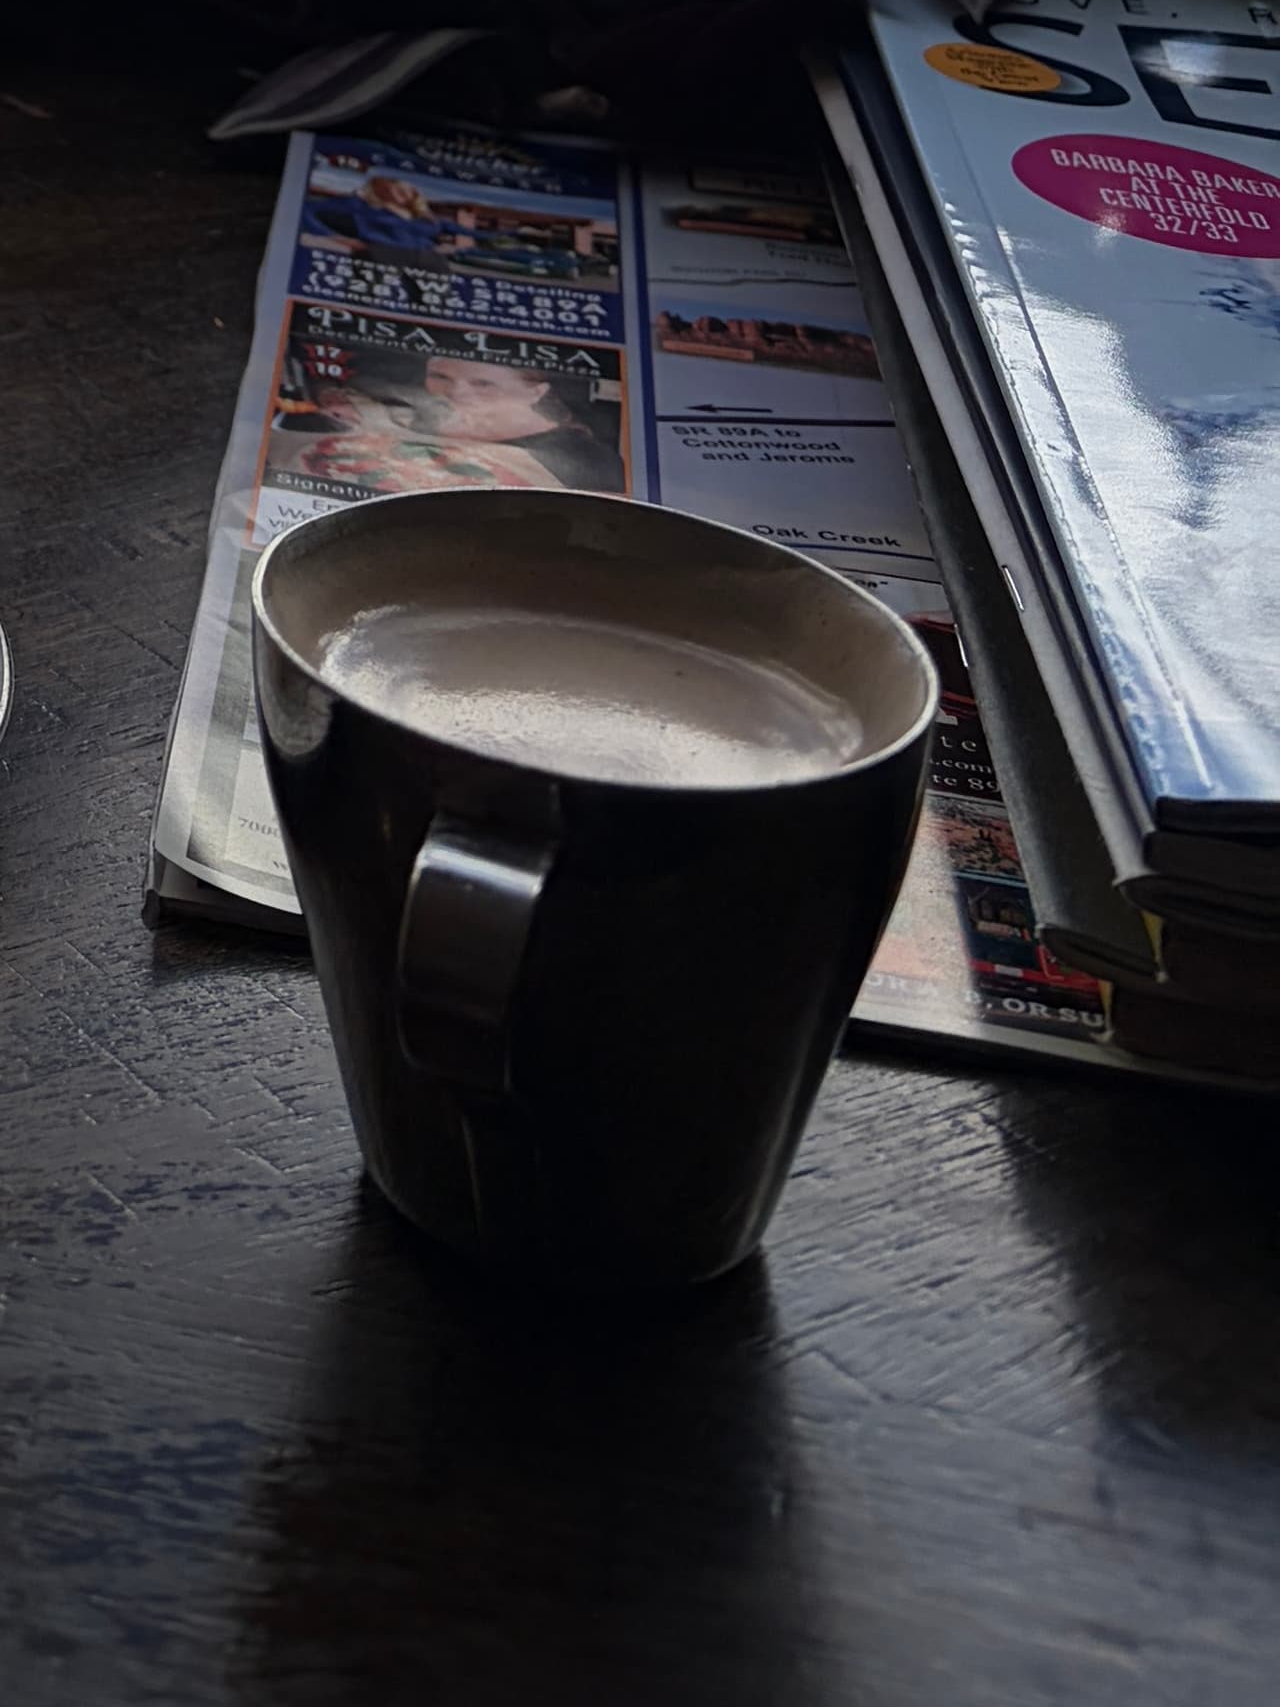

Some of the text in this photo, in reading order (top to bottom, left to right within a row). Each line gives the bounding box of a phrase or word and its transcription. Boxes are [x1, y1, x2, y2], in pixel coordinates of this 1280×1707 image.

[1050, 149, 1280, 198] BARBARA BAKER
[1131, 176, 1224, 206] AT THE
[1098, 187, 1271, 230] CENTERFOLD
[1149, 212, 1238, 242] 32/33
[312, 250, 398, 273] Express
[403, 266, 465, 284] Wash
[496, 281, 601, 303] Detailing
[312, 260, 401, 286] 1515
[474, 288, 518, 304] SR
[533, 296, 608, 316] 89A
[302, 284, 611, 337] cleanerquickercarwash.com
[309, 272, 600, 327] (928) 862-4001
[308, 325, 600, 376] Decadent Wood Fired Pizza
[315, 344, 341, 359] 17
[672, 426, 801, 437] SR 89A to
[682, 438, 841, 451] Cottonwood
[702, 452, 856, 464] and Jerome
[752, 524, 901, 547] Oak Creek
